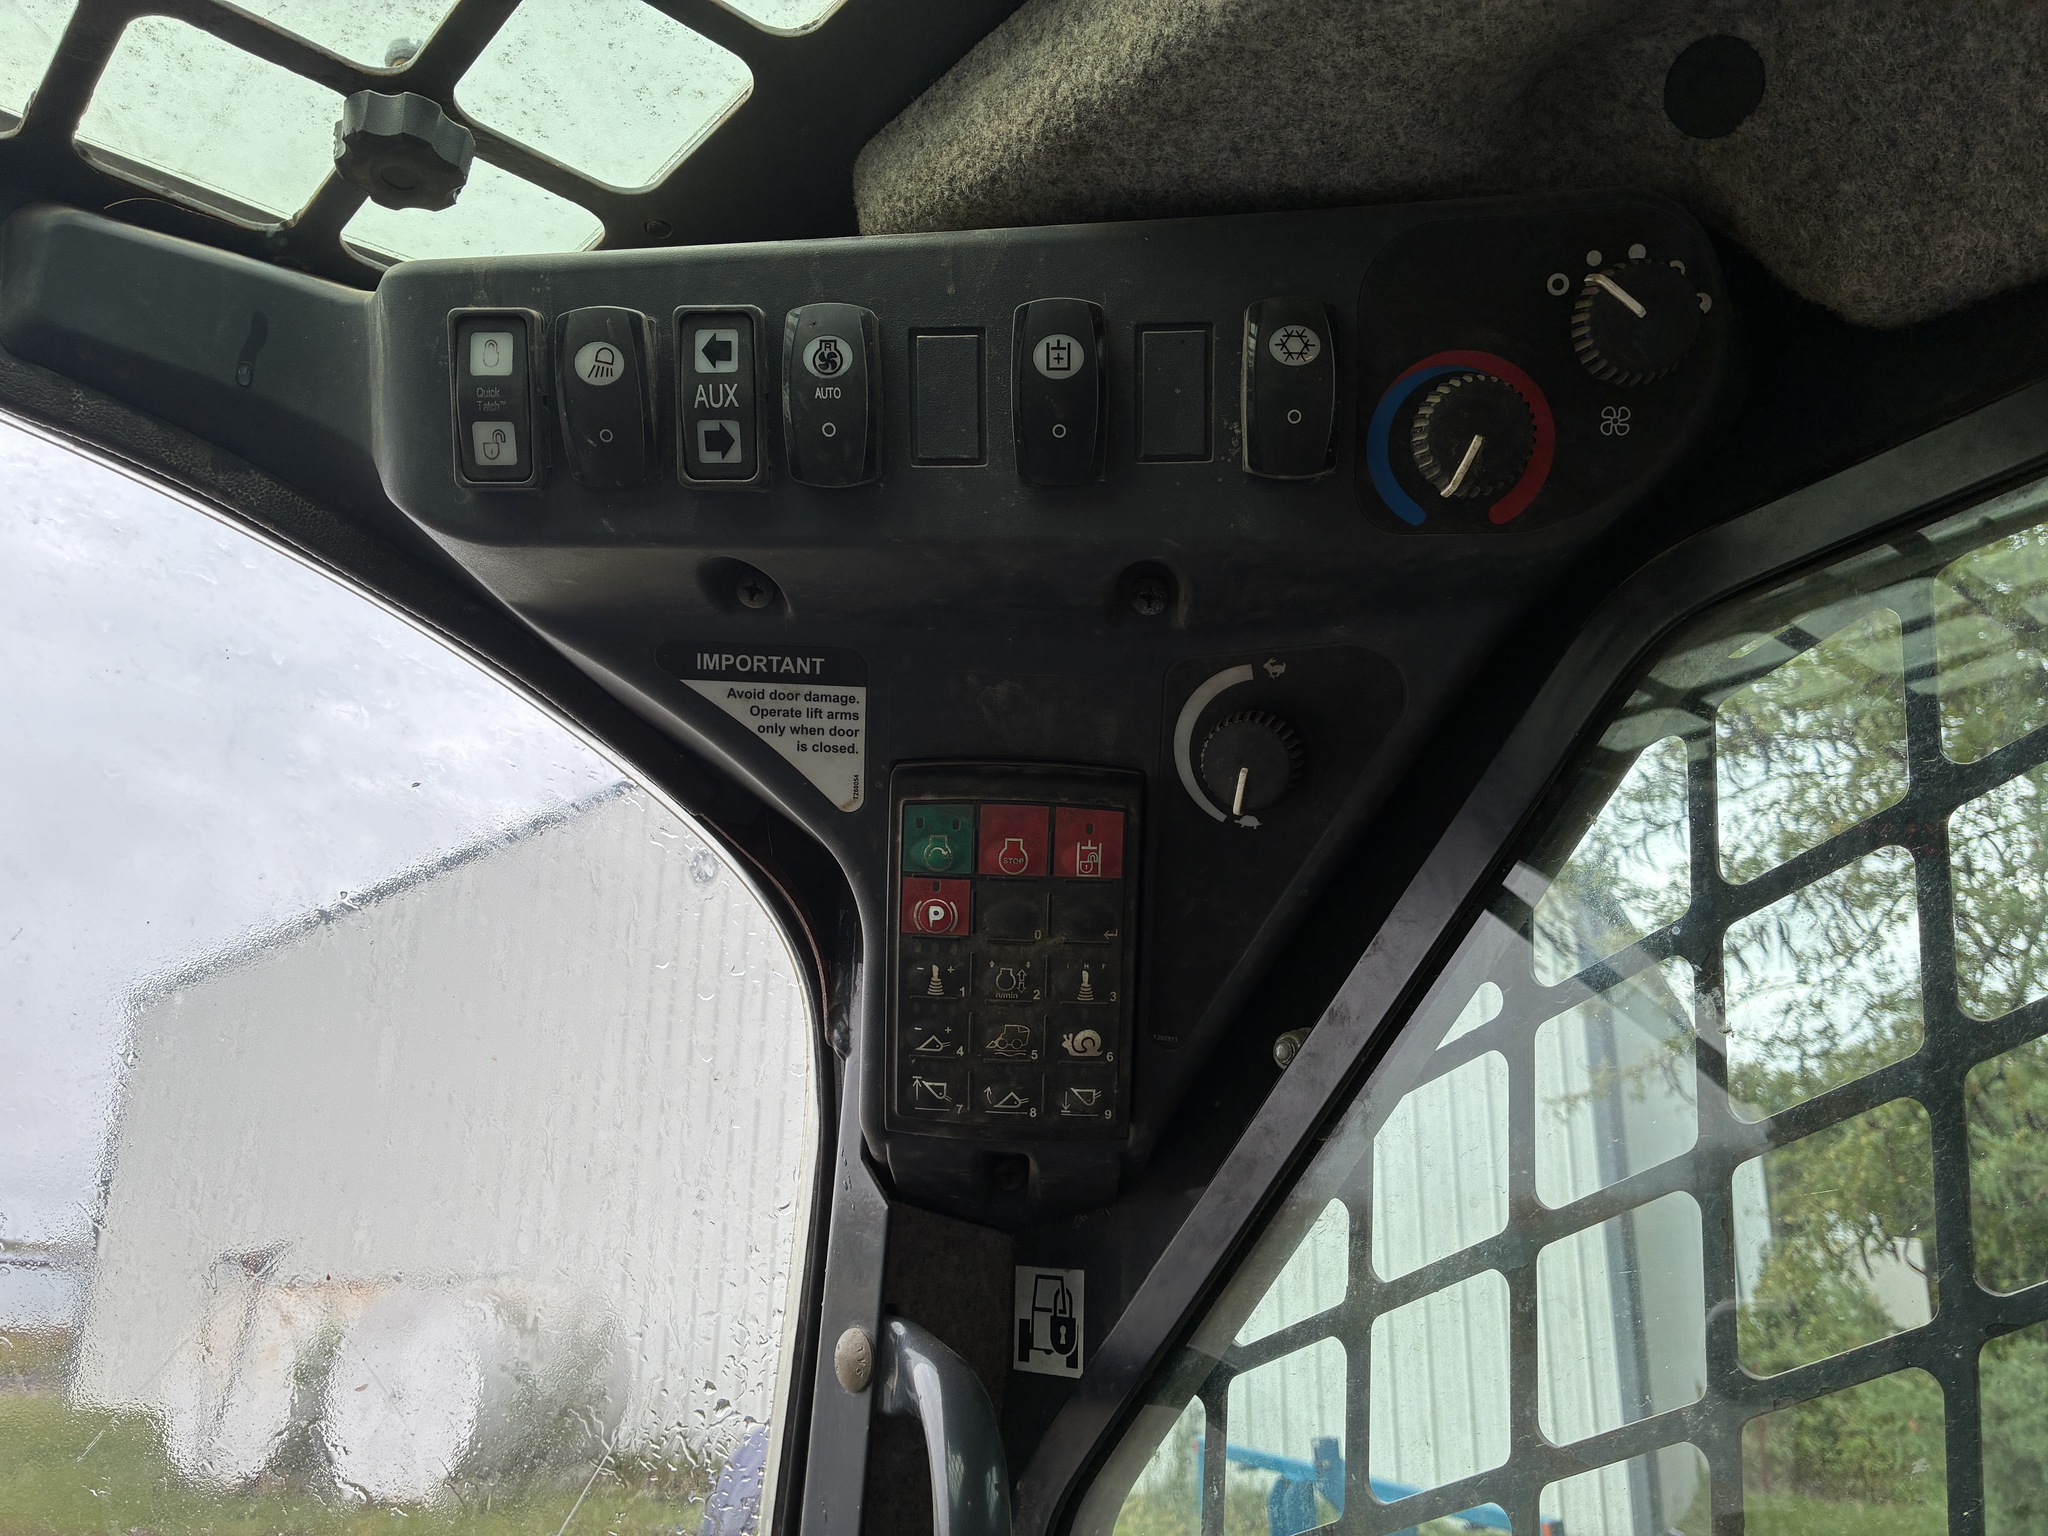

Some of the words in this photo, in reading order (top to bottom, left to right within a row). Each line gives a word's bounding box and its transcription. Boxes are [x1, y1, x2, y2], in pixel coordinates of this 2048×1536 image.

[476, 387, 500, 398] Quick
[694, 383, 739, 408] AUX
[814, 387, 842, 399] AUTO
[696, 653, 825, 675] IMPORTANT
[727, 688, 765, 701] Avoid
[769, 689, 800, 702] door
[804, 690, 860, 706] damage.
[750, 705, 802, 719] Operate
[806, 707, 823, 719] lift
[827, 711, 860, 721] arms
[757, 723, 786, 736] only
[790, 725, 825, 736] when
[829, 726, 860, 738] door
[796, 741, 808, 752] is
[812, 742, 859, 754] closed.
[1003, 857, 1024, 865] STOP
[928, 905, 945, 928] P
[959, 987, 966, 997] 1
[1032, 989, 1041, 1000] 2
[1109, 991, 1118, 1002] 3
[956, 1045, 965, 1056] 4
[1031, 1049, 1039, 1060] 5
[1105, 1051, 1114, 1062] 6
[956, 1104, 964, 1115] 7
[1029, 1107, 1037, 1118] 8
[1104, 1108, 1112, 1119] 9
